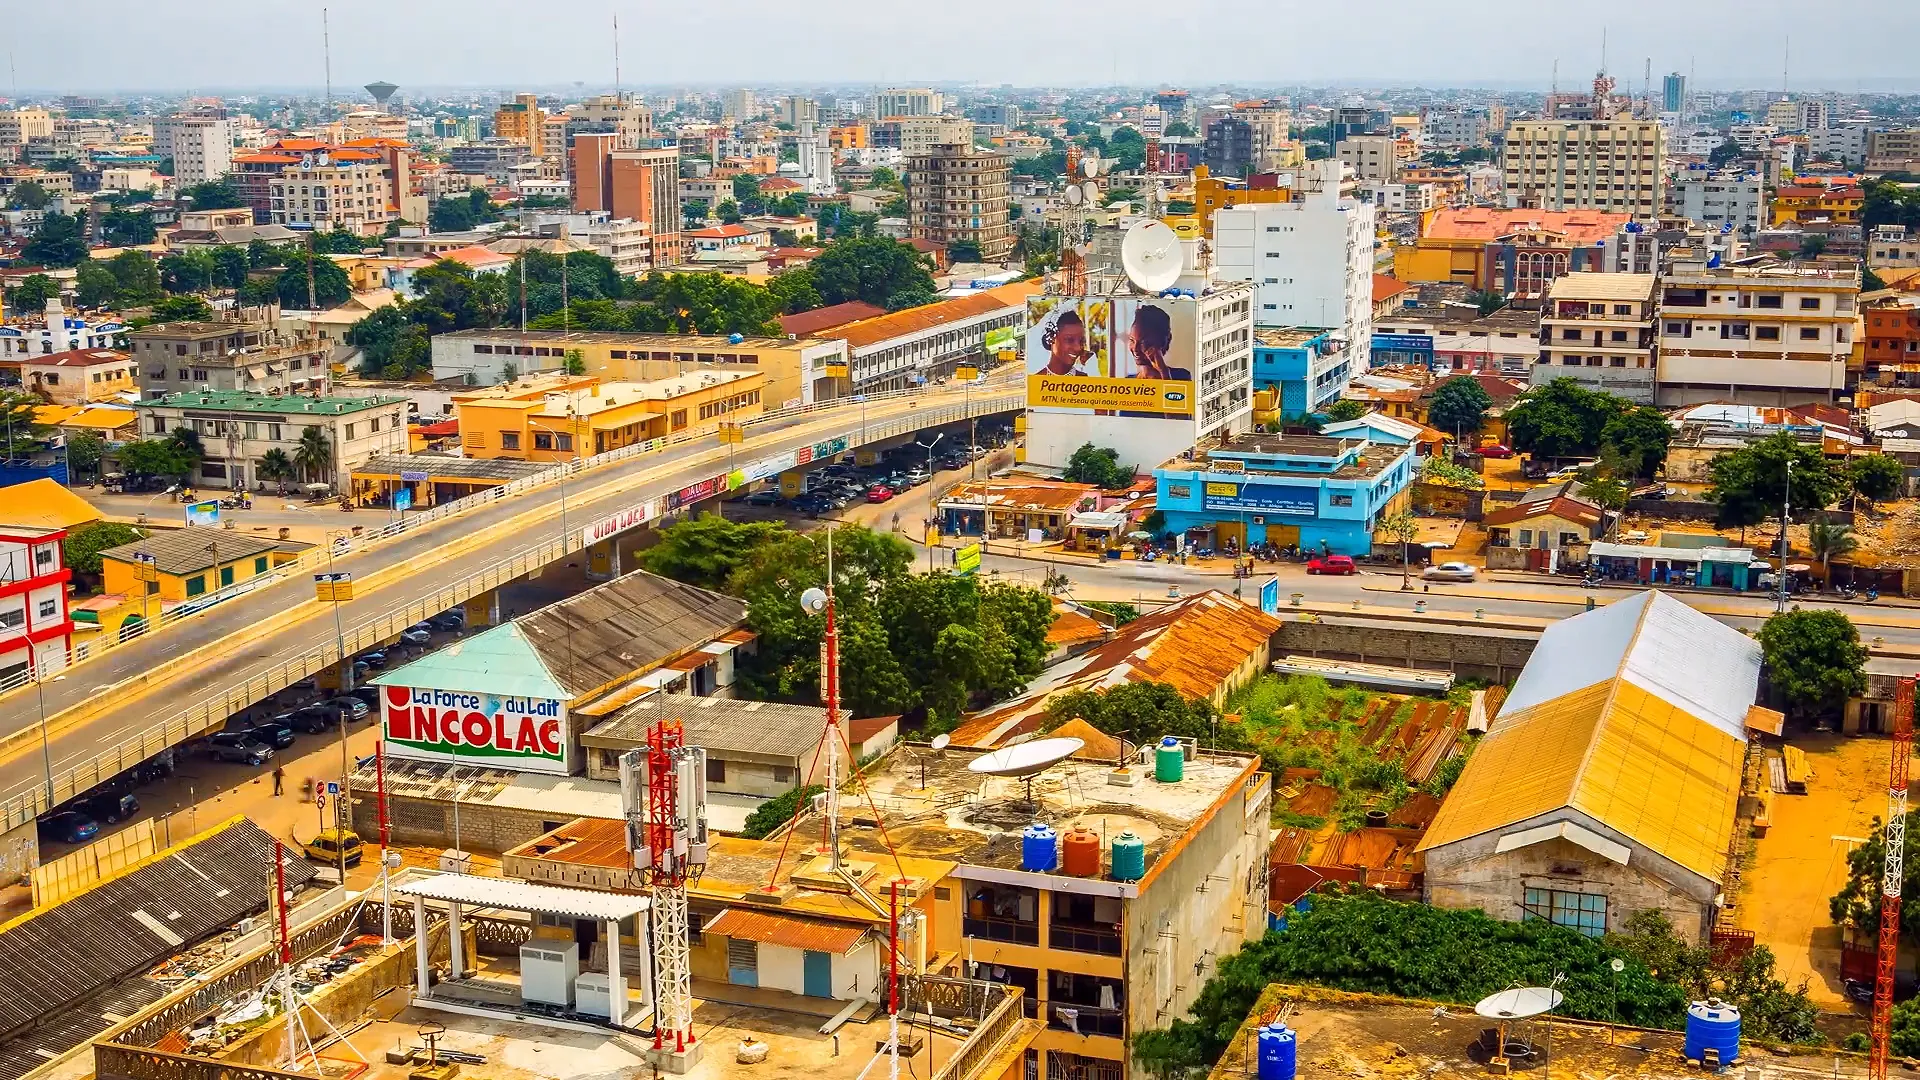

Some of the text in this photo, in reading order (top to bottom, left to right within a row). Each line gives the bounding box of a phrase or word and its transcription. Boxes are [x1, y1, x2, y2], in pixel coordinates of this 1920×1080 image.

[1040, 380, 1156, 396] Partageons nos vies
[1041, 395, 1059, 404] MTN,
[1066, 397, 1089, 405] réseau
[1089, 398, 1101, 406] qui
[1118, 400, 1155, 408] rassemble.
[412, 687, 560, 717] La Force du Lait
